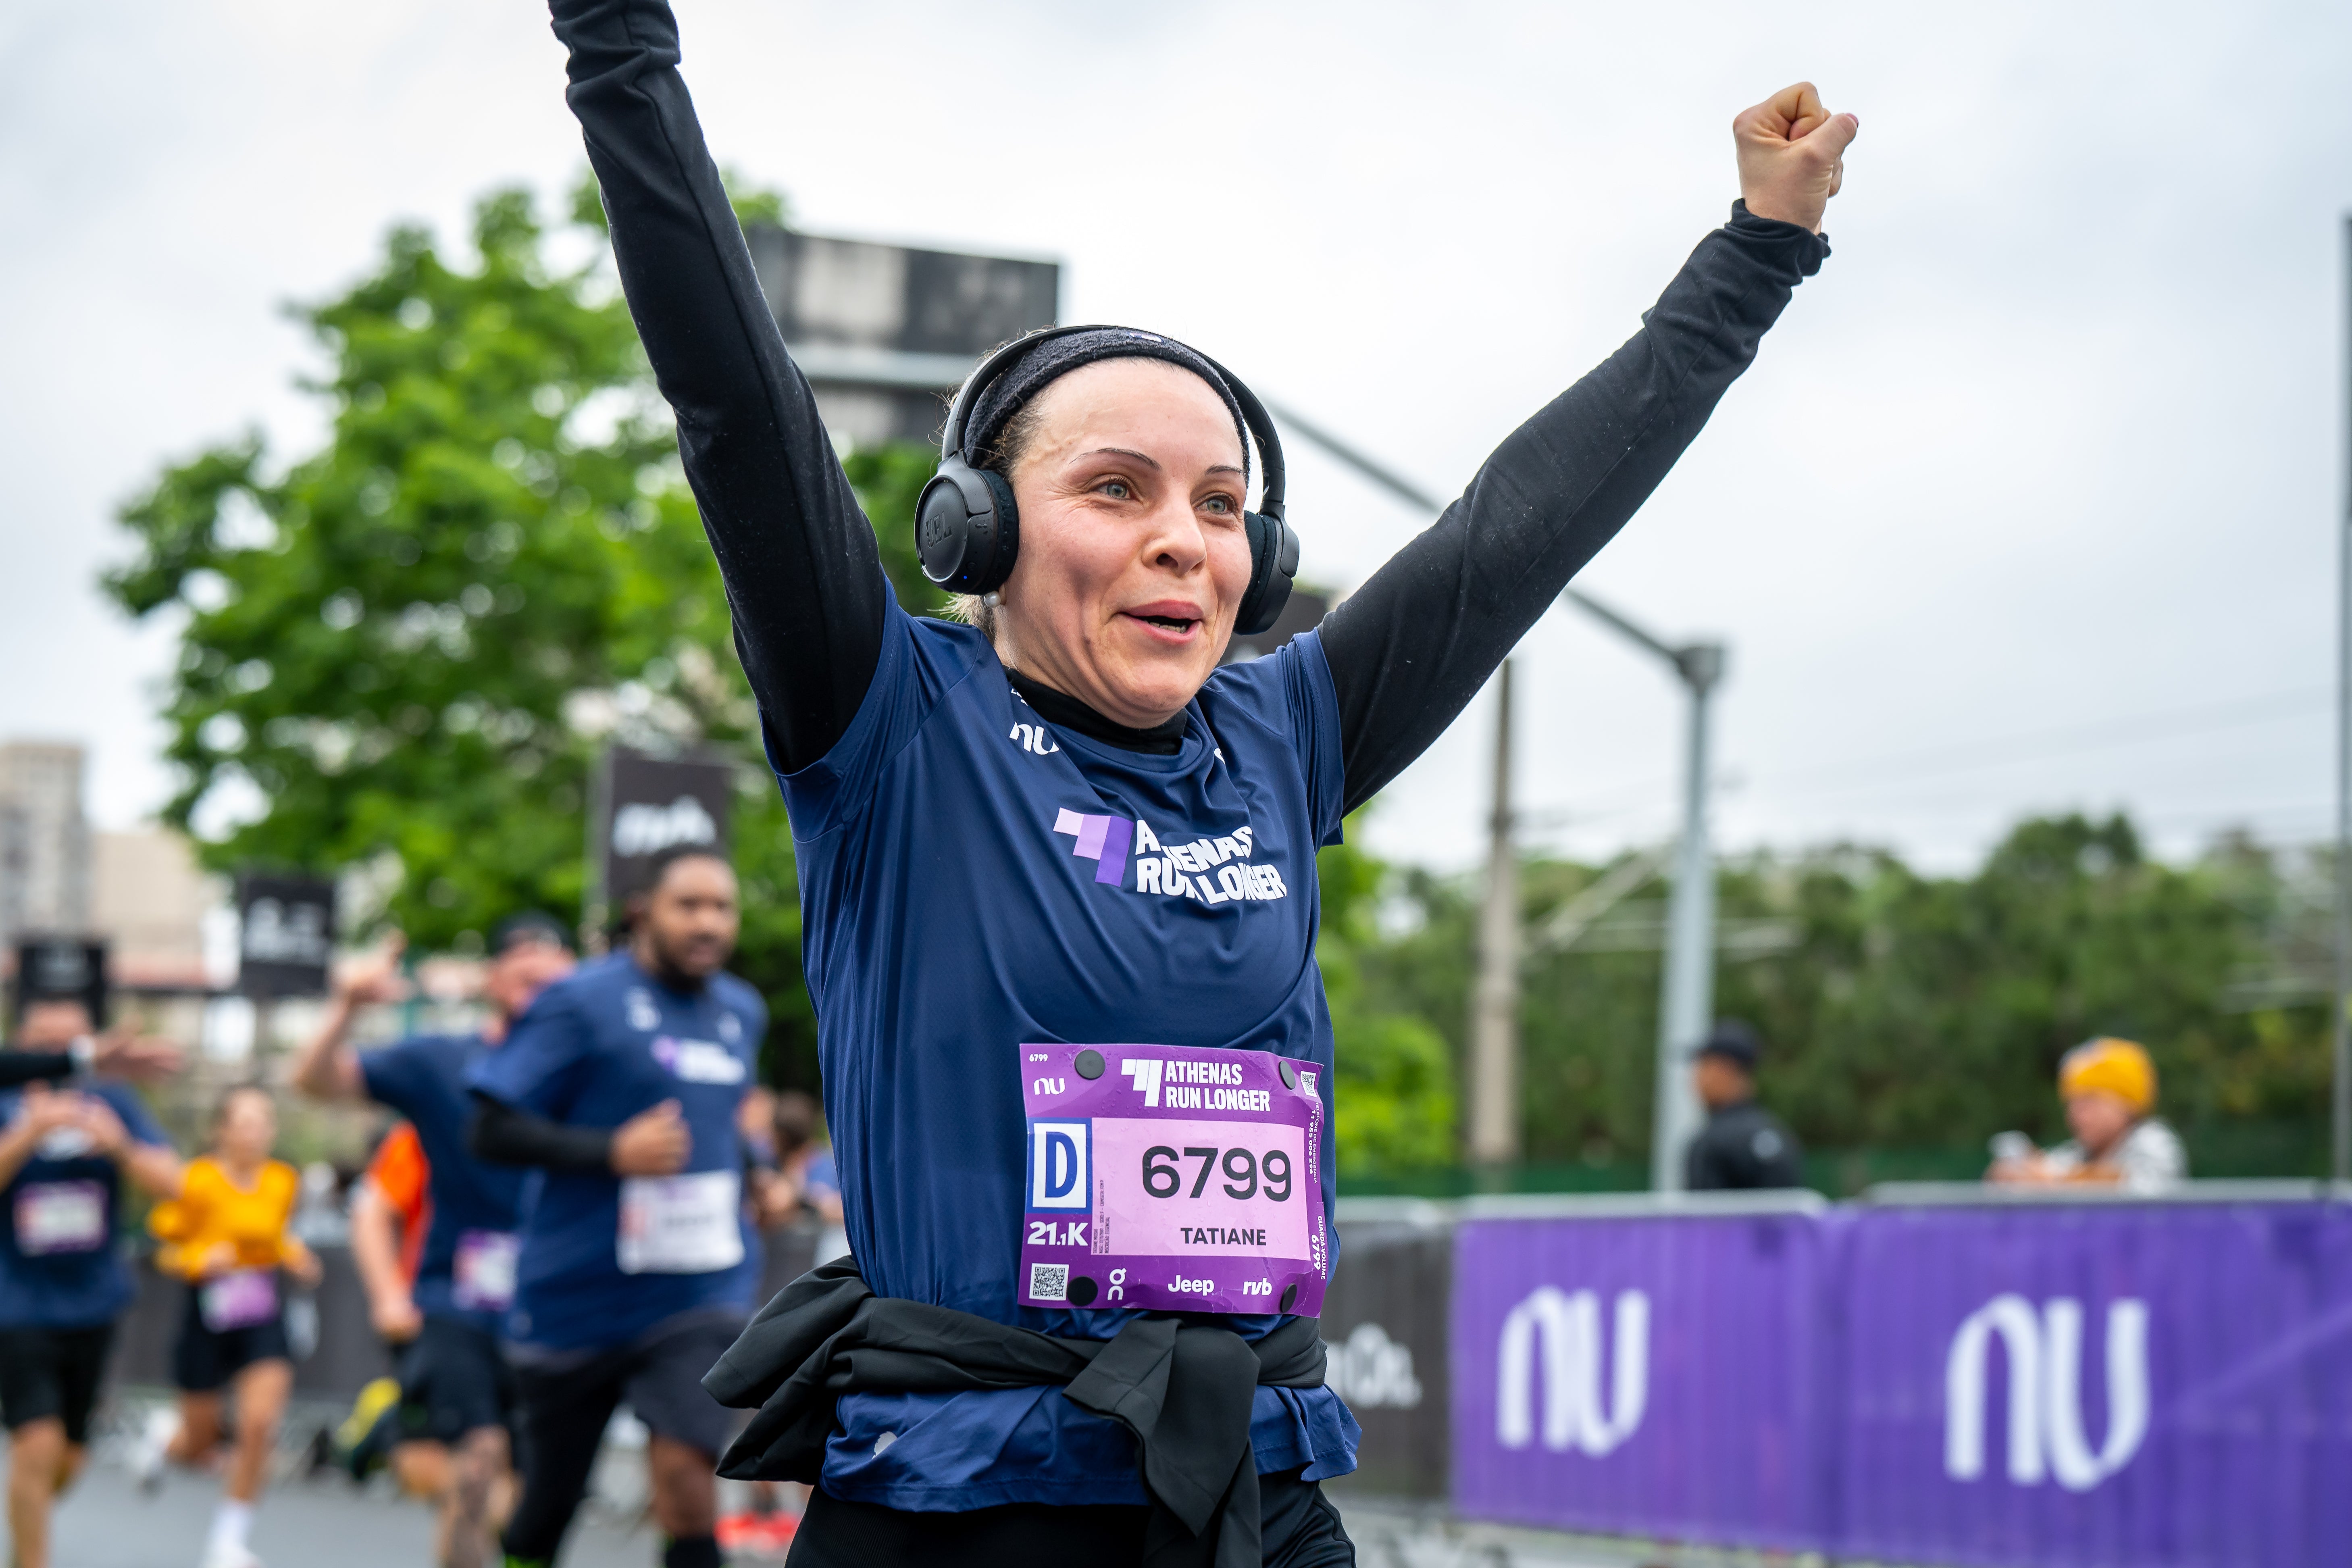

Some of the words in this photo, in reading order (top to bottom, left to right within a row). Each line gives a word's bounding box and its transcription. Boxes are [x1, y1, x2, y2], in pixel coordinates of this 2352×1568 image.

[925, 511, 953, 549] JBL
[1135, 819, 1253, 872] AENAS
[1029, 1054, 1048, 1062] 6799
[1165, 1060, 1243, 1085] ATHENAS
[1034, 1078, 1065, 1095] nu
[1166, 1090, 1201, 1110] RUN
[1208, 1091, 1271, 1112] LONGER
[1310, 1110, 1316, 1119] 11
[1313, 1133, 1317, 1142] DE
[1045, 1132, 1078, 1198] D
[1142, 1145, 1291, 1202] 6799
[1028, 1221, 1088, 1246] 21.1K
[1180, 1228, 1266, 1245] TATIANE
[1311, 1234, 1321, 1270] 6799
[1318, 1215, 1326, 1280] GUARDA-VOLUME
[1168, 1275, 1214, 1296] Jeep
[1243, 1277, 1272, 1295] rvb
